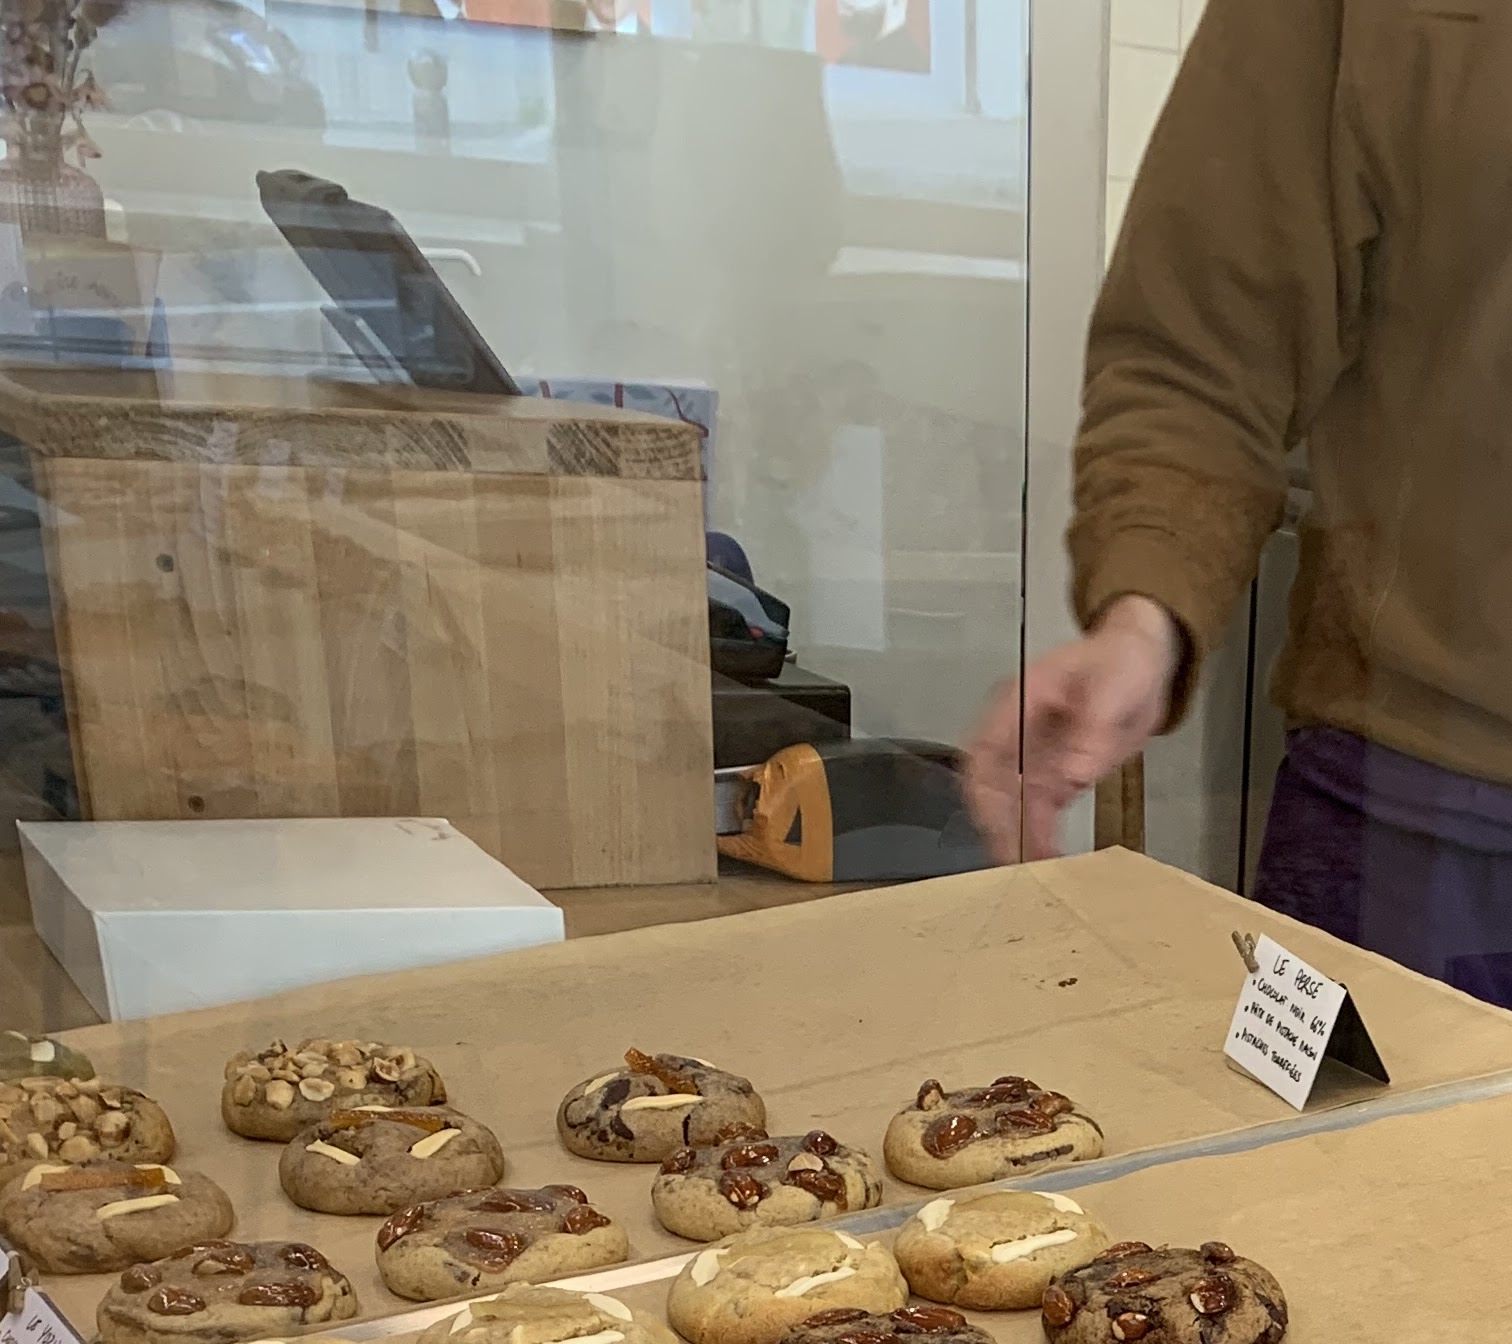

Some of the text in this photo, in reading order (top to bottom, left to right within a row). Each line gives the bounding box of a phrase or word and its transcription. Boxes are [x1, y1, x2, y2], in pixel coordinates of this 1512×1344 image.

[1273, 955, 1323, 999] LE PERSE
[1258, 978, 1288, 1005] CHOCOLAT
[1266, 1013, 1274, 1026] DE
[26, 1315, 42, 1331] LE
